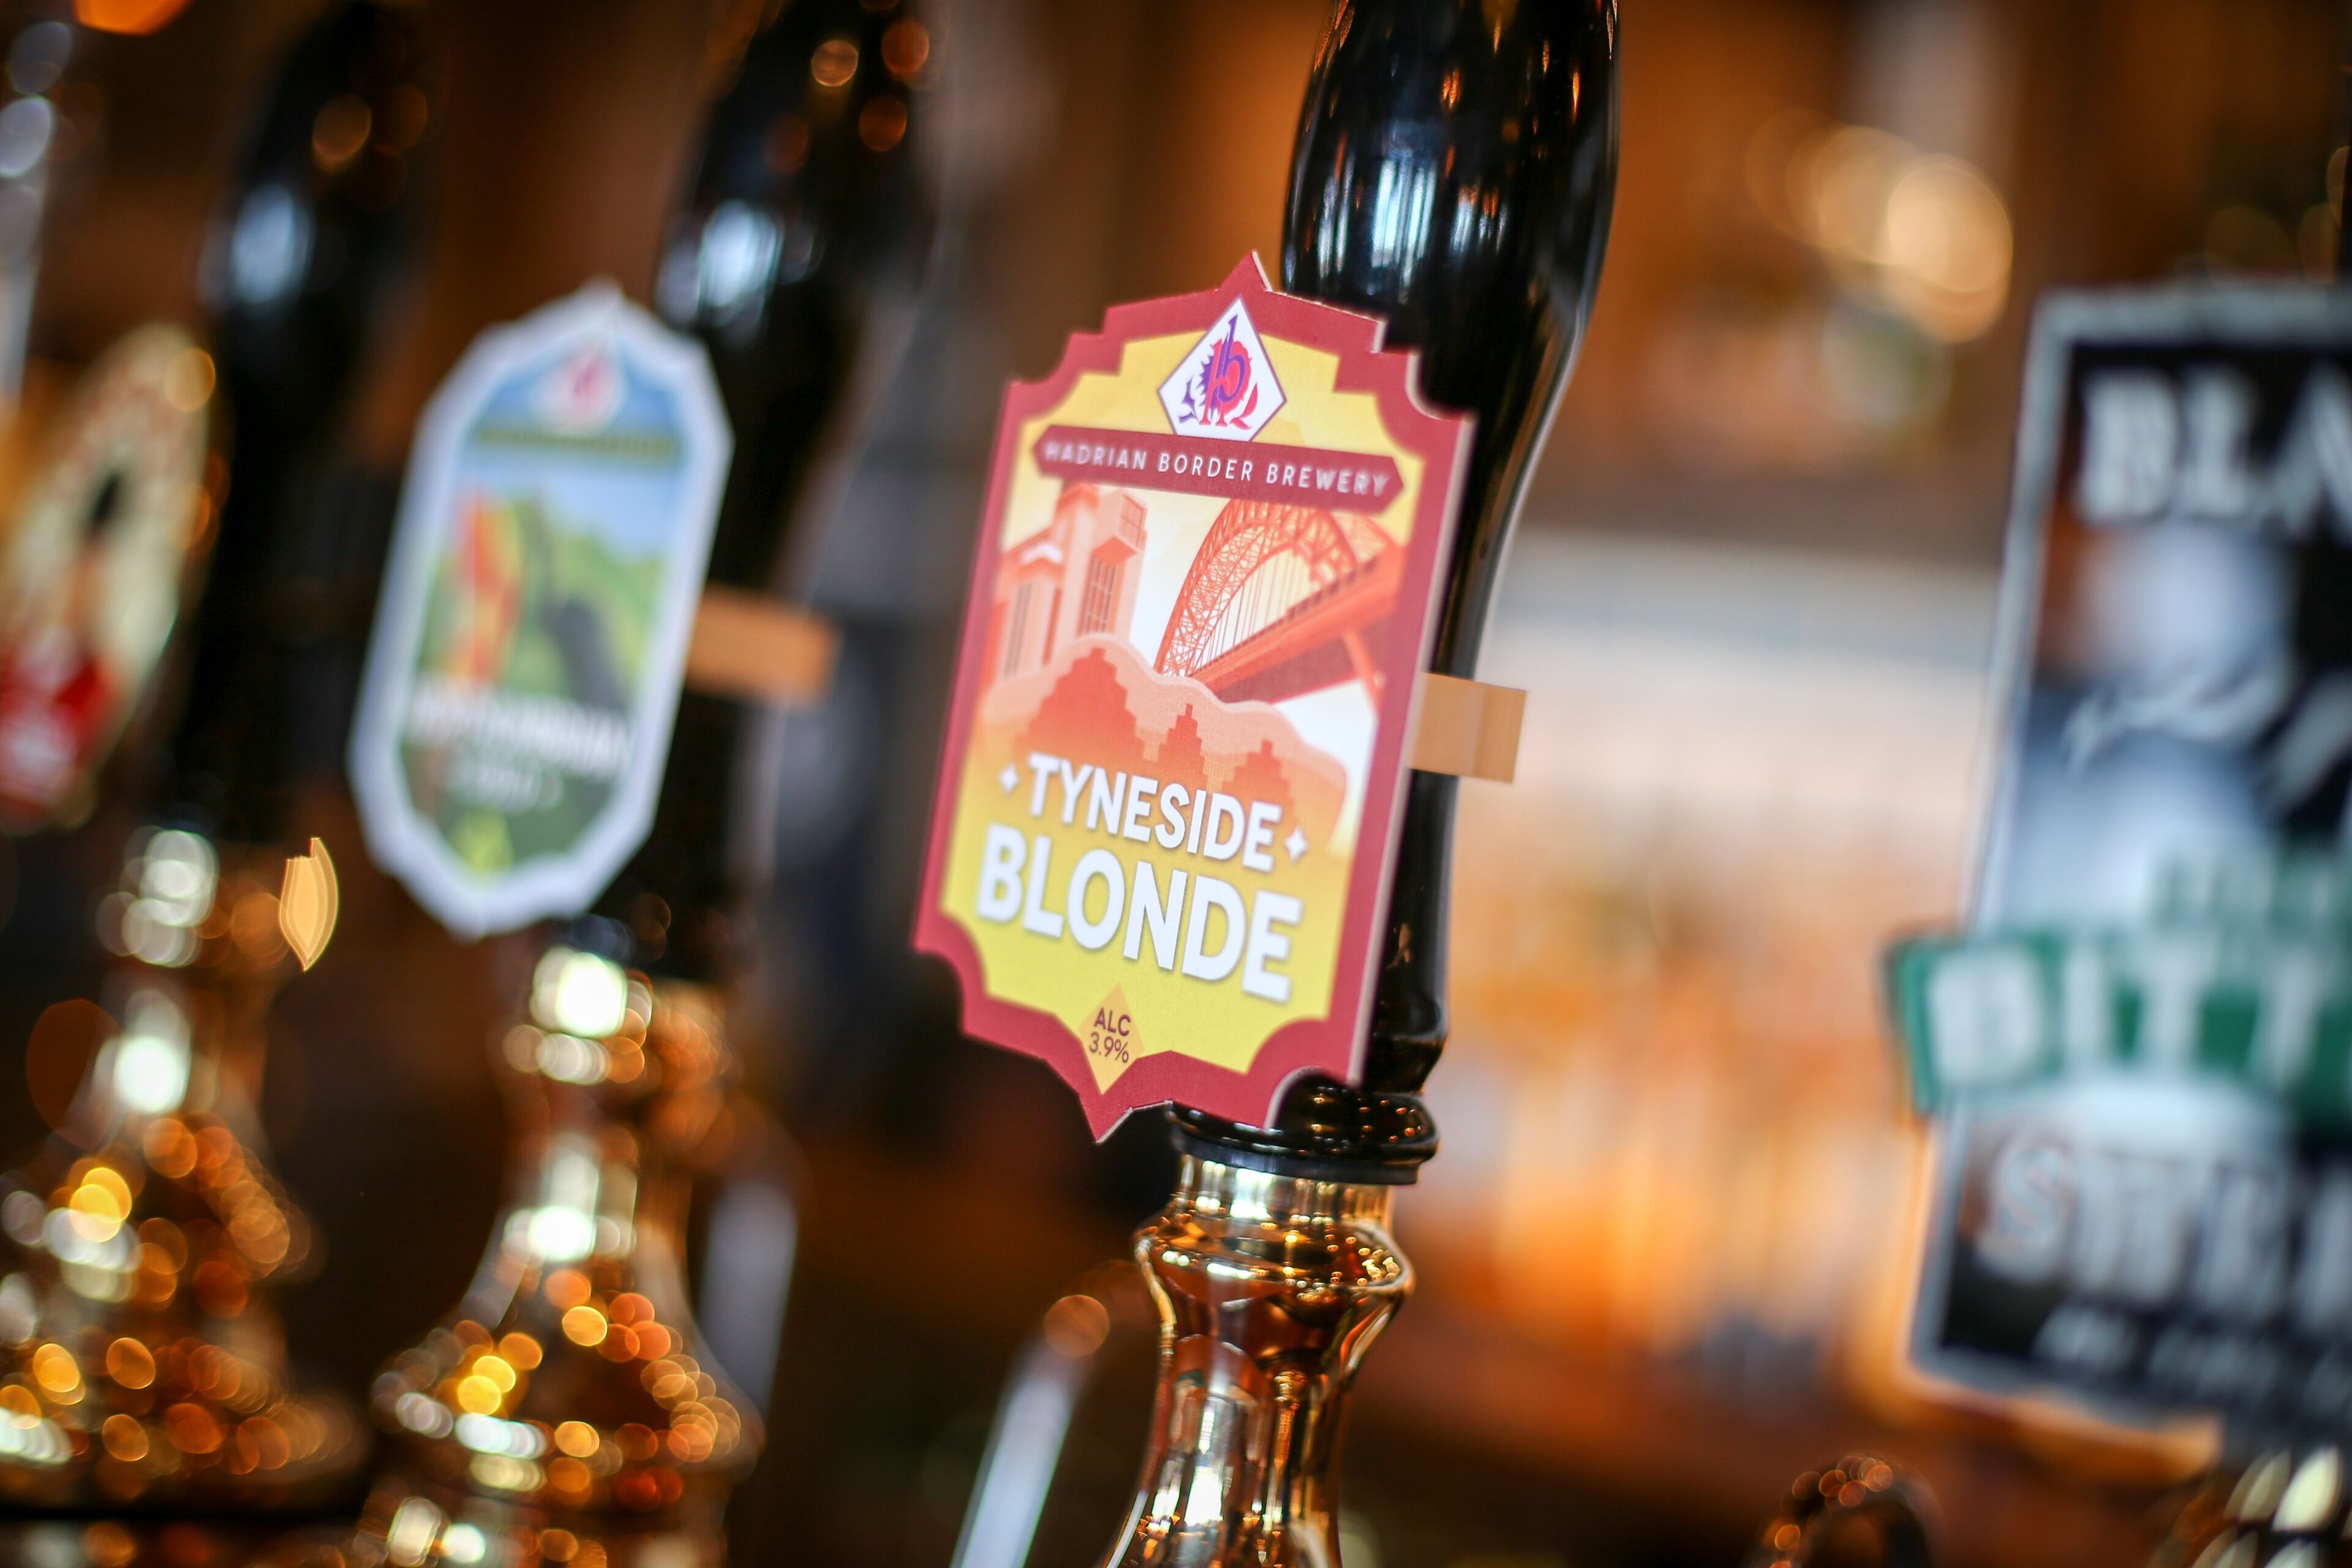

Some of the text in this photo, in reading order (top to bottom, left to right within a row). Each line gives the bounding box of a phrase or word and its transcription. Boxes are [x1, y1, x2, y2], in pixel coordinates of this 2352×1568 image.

[1043, 440, 1390, 497] HADRIAN BORDER BREWERY
[1028, 752, 1282, 872] TYNESIDE
[976, 823, 1303, 1003] BLONDE
[1089, 1033, 1129, 1064] 3.9%
[1093, 1008, 1132, 1036] ALC
